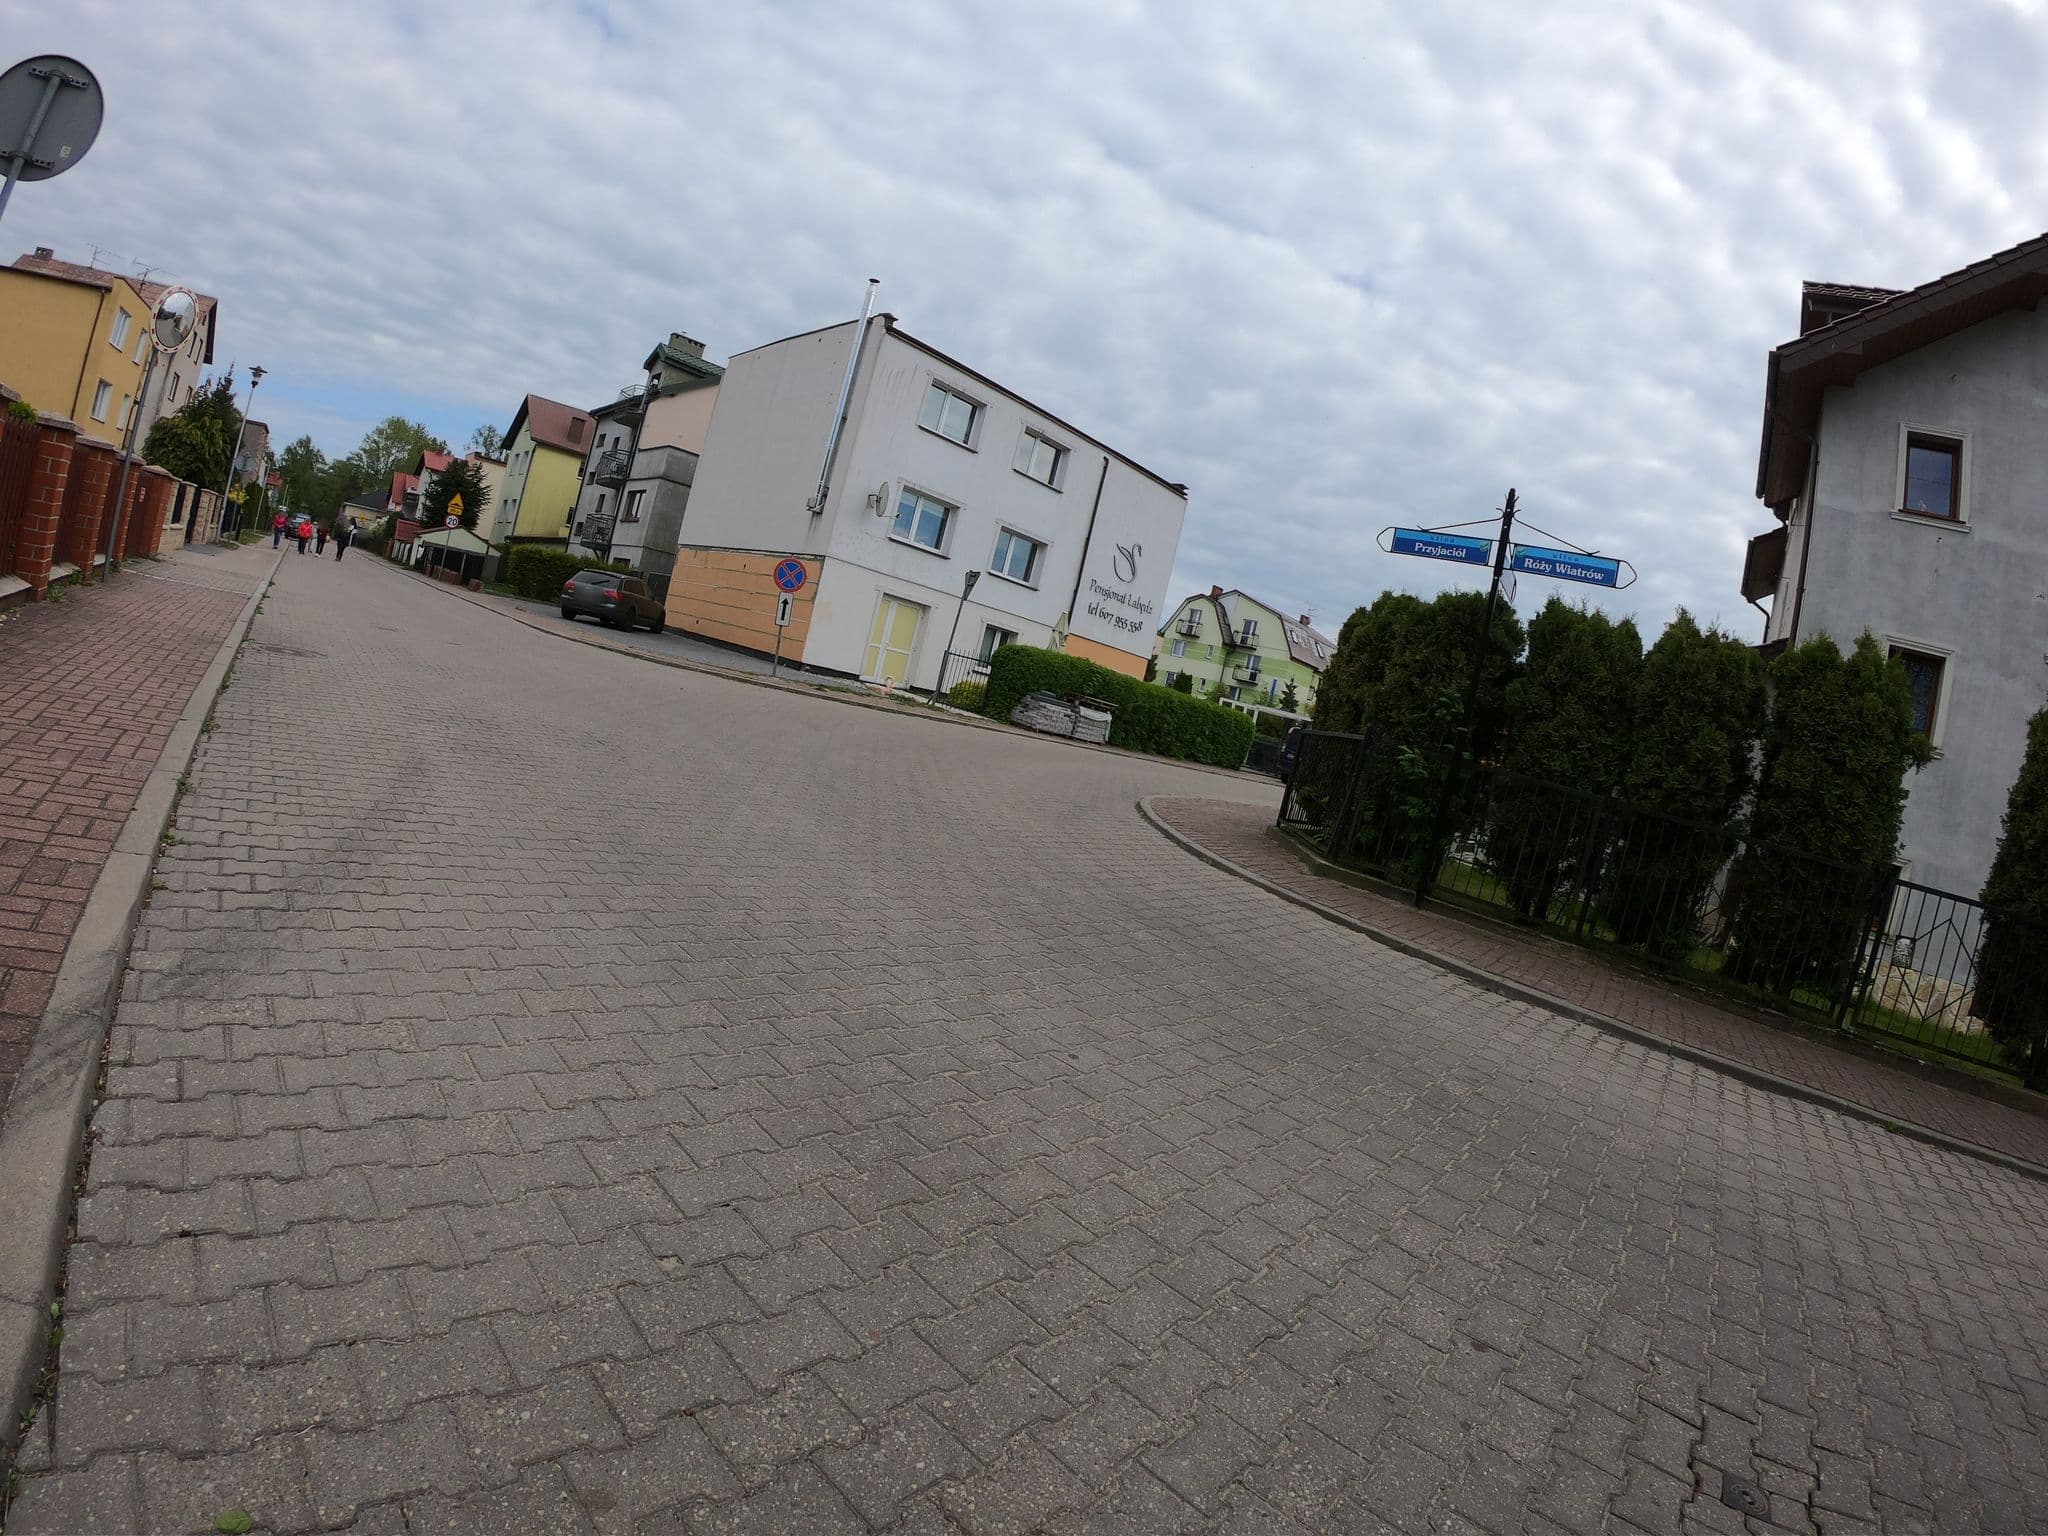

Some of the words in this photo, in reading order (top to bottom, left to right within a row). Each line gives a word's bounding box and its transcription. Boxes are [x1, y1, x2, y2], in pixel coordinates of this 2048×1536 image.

[448, 517, 457, 526] 20
[1524, 558, 1552, 572] Róży
[1555, 563, 1604, 580] Wiatrów
[1089, 579, 1126, 604] Pensjonat
[1088, 602, 1099, 616] tel
[1099, 607, 1114, 624] 607
